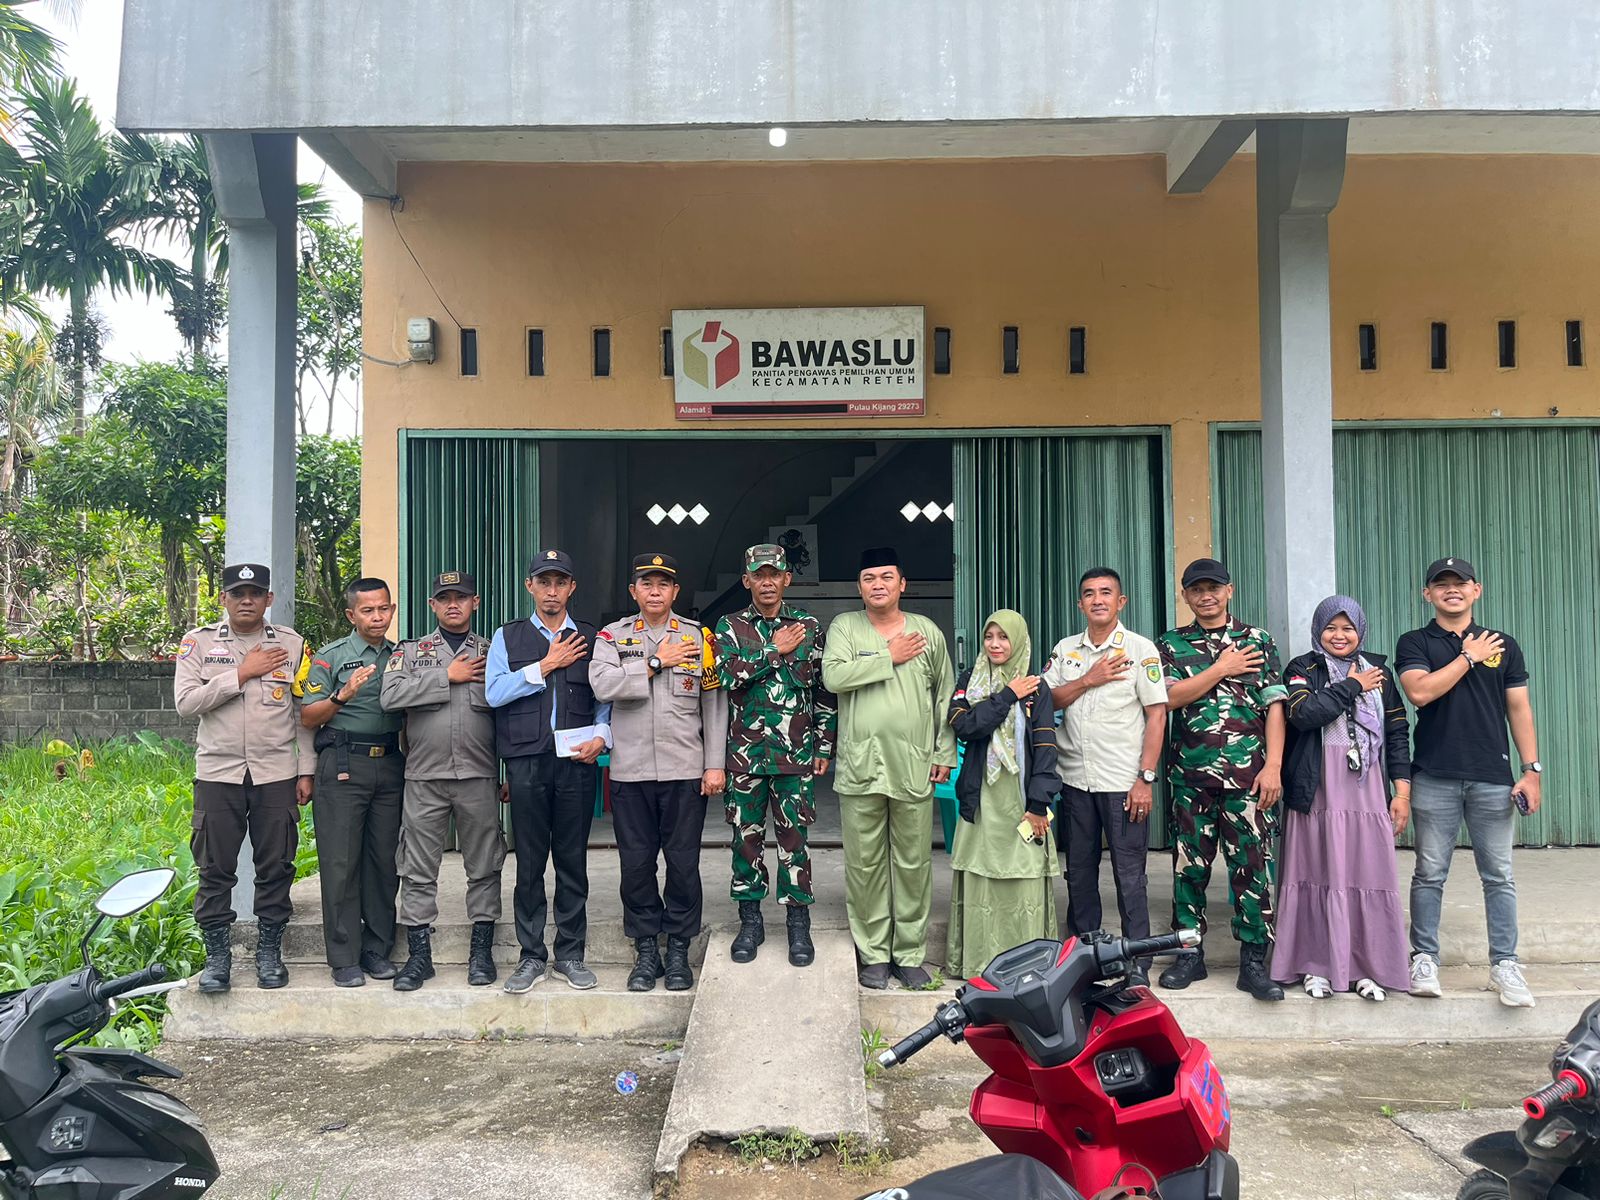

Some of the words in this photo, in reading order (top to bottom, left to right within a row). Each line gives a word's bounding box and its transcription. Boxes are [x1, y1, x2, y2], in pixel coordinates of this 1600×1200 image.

[752, 339, 915, 368] BAWASLU
[788, 369, 837, 377] PENGAWAS
[839, 368, 887, 376] PEMILIHAN
[752, 377, 851, 387] KECAMATAN
[863, 376, 915, 385] RETEH
[679, 406, 706, 414] Alamat
[849, 403, 871, 411] Pulau
[872, 403, 896, 412] Kijang
[897, 402, 920, 410] 29273
[411, 659, 432, 668] YUDI
[174, 1176, 206, 1188] HONDA
